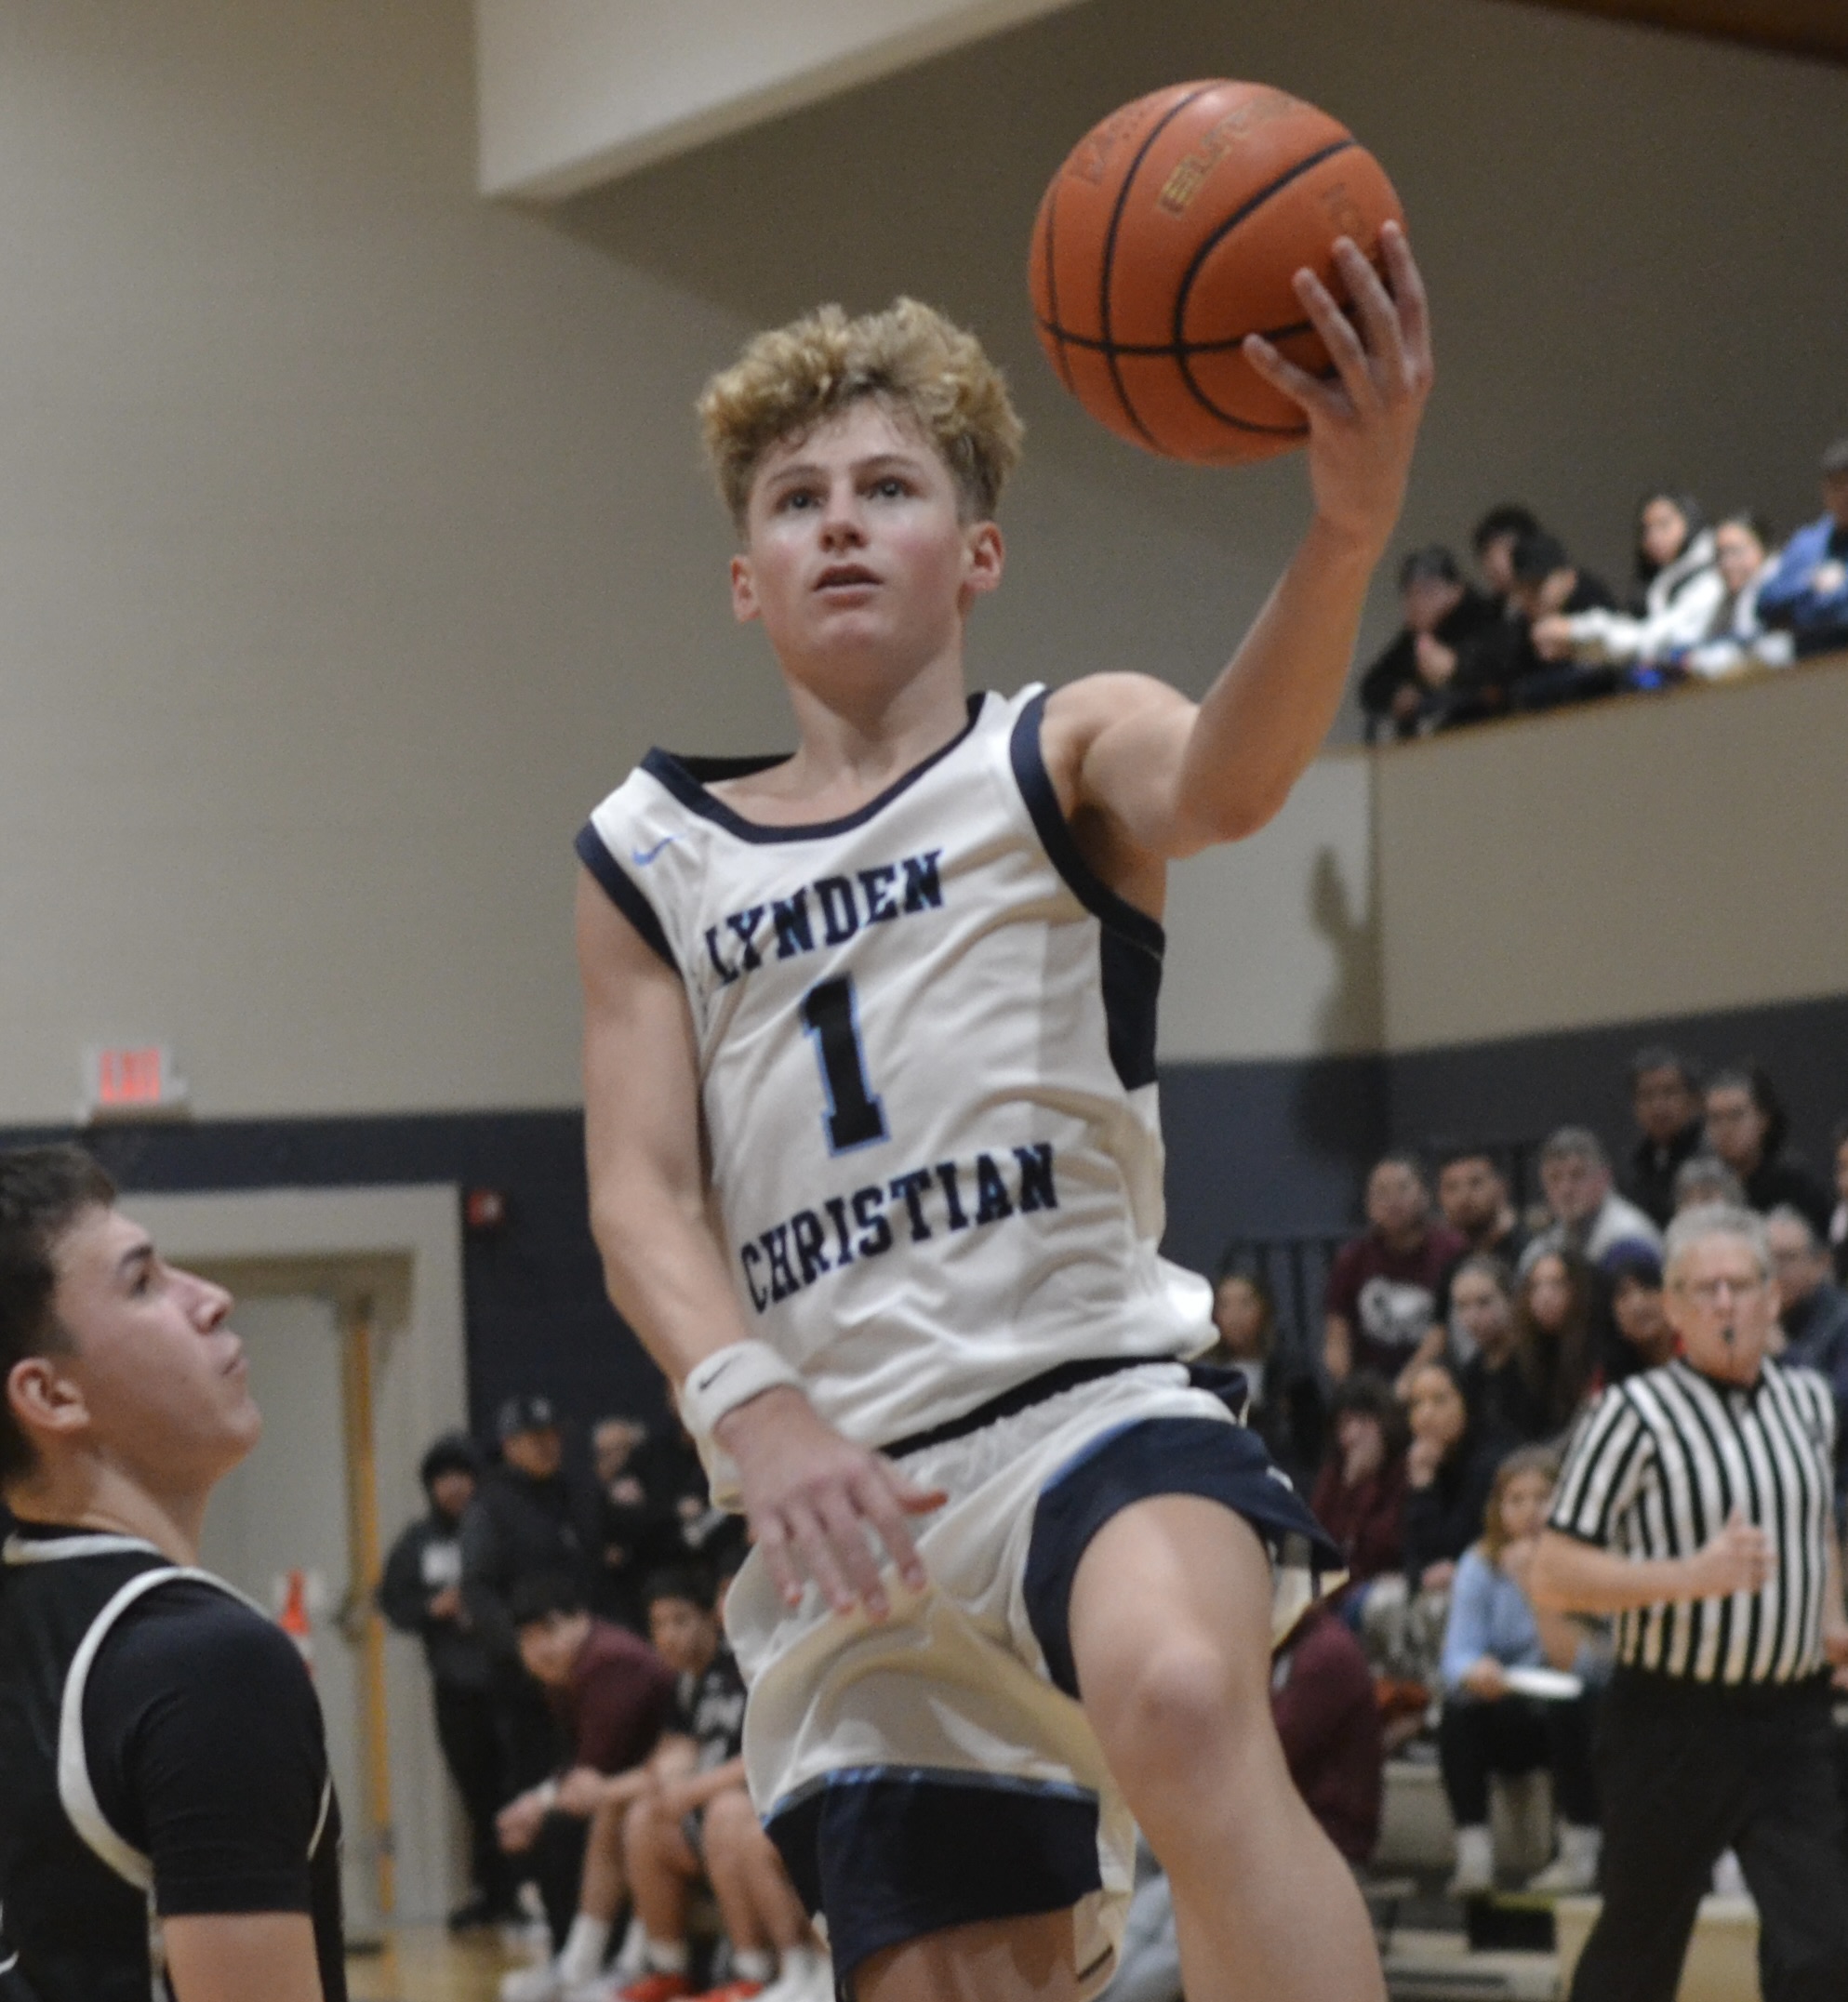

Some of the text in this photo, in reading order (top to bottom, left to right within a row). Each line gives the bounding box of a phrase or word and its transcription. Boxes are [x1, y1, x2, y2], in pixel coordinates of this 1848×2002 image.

[705, 849, 945, 986] LYNDEN
[798, 970, 891, 1160] 1
[740, 1142, 1058, 1316] CHRISTIAN
